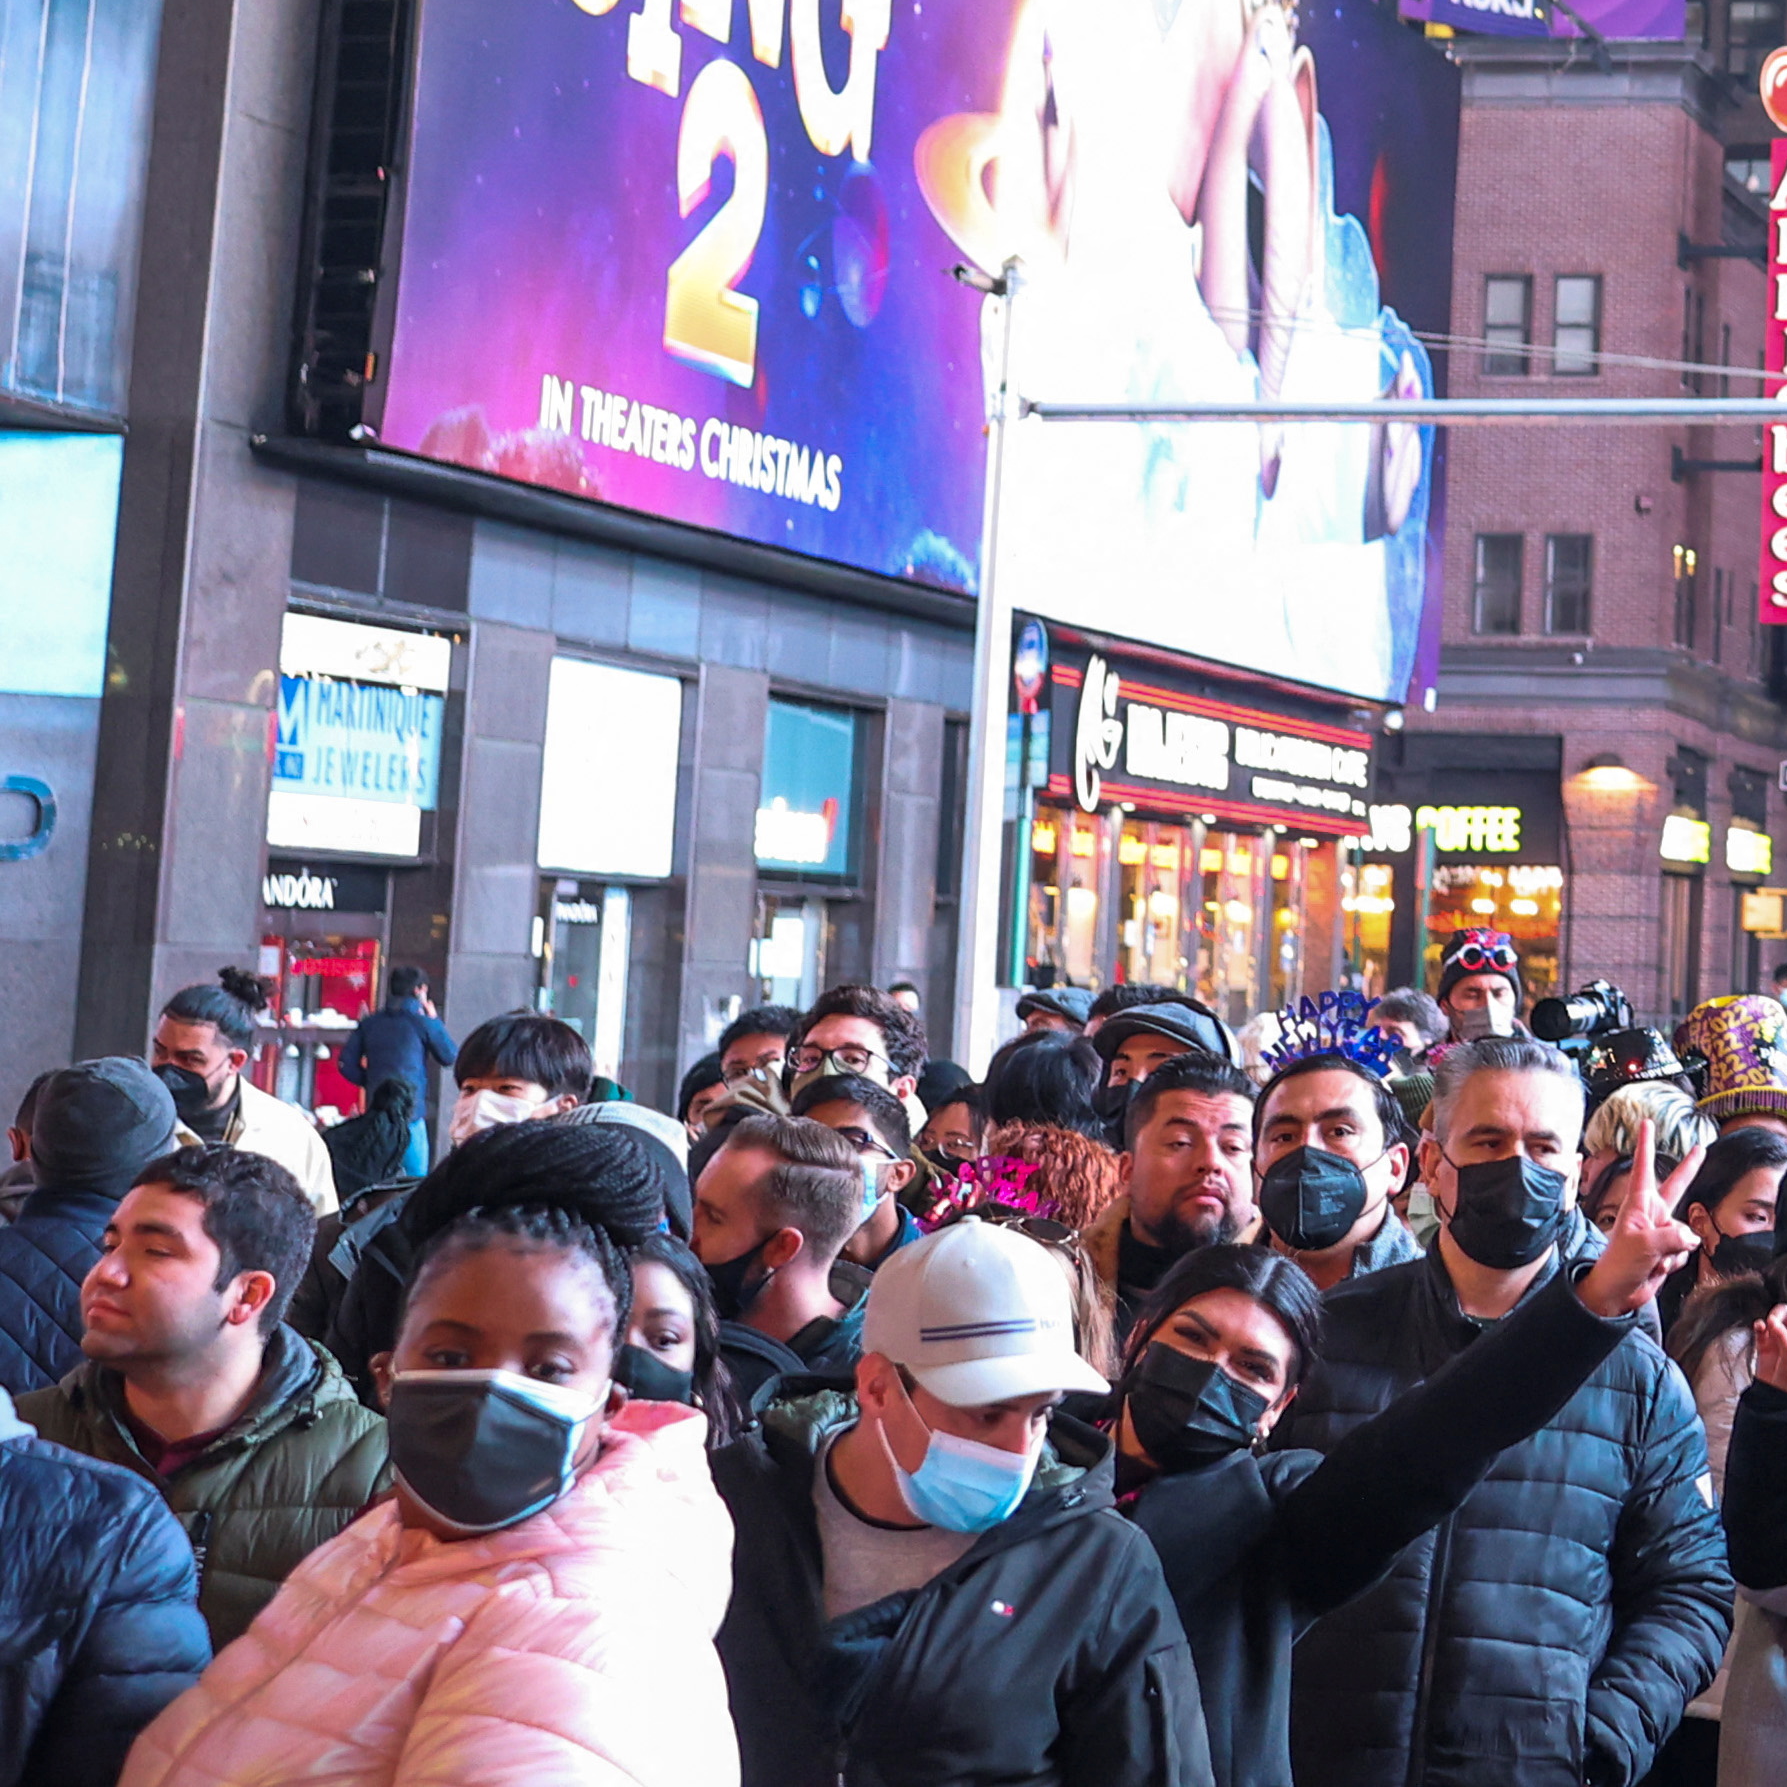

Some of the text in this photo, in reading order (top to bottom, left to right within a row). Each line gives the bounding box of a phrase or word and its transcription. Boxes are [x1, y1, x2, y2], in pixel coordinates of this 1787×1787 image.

[662, 57, 769, 389] 2
[540, 373, 843, 513] IN THEATERS CHRISTMAS
[317, 677, 432, 742] MARTINIQUE
[313, 745, 428, 795] JEWELERS
[262, 866, 335, 910] ANDORA
[1277, 989, 1382, 1028] HAPPY
